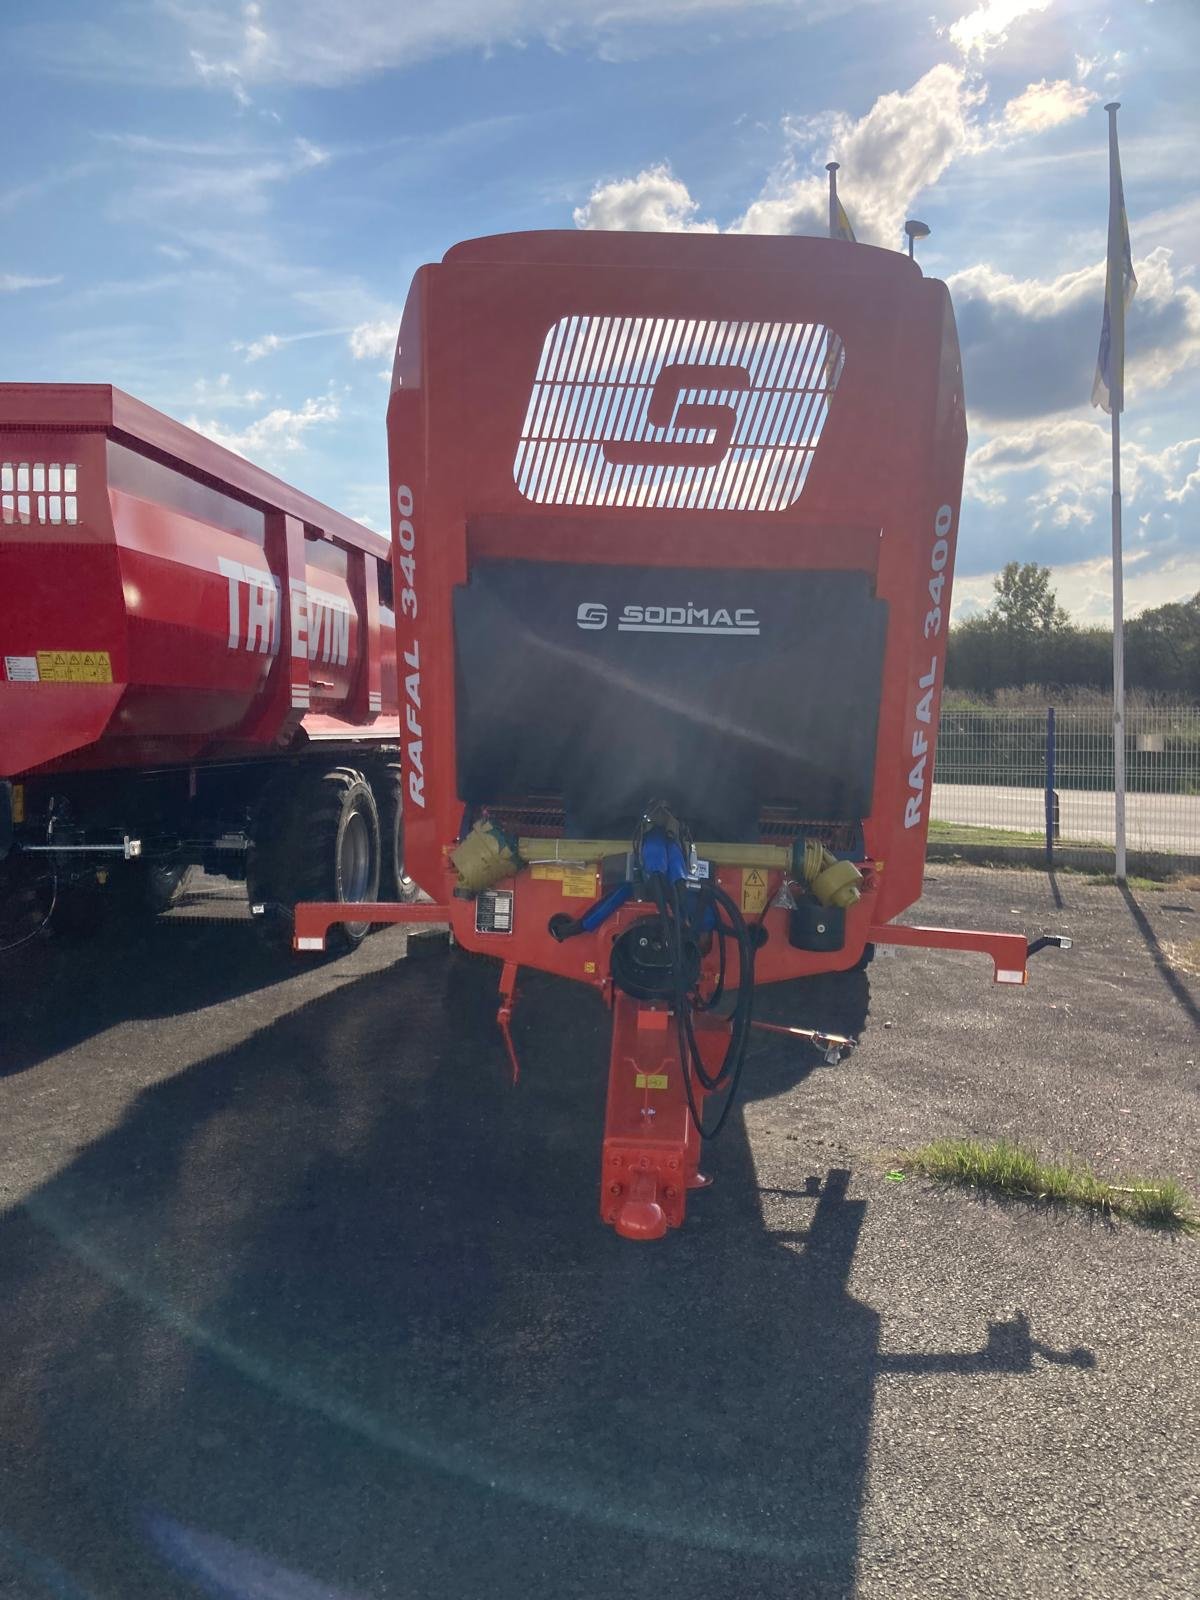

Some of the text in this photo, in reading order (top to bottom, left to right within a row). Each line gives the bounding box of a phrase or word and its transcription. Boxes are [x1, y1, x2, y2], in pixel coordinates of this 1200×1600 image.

[217, 556, 350, 666] THIEVIN
[397, 484, 425, 808] RAFAL 3400
[904, 504, 952, 829] RAFAL 3400
